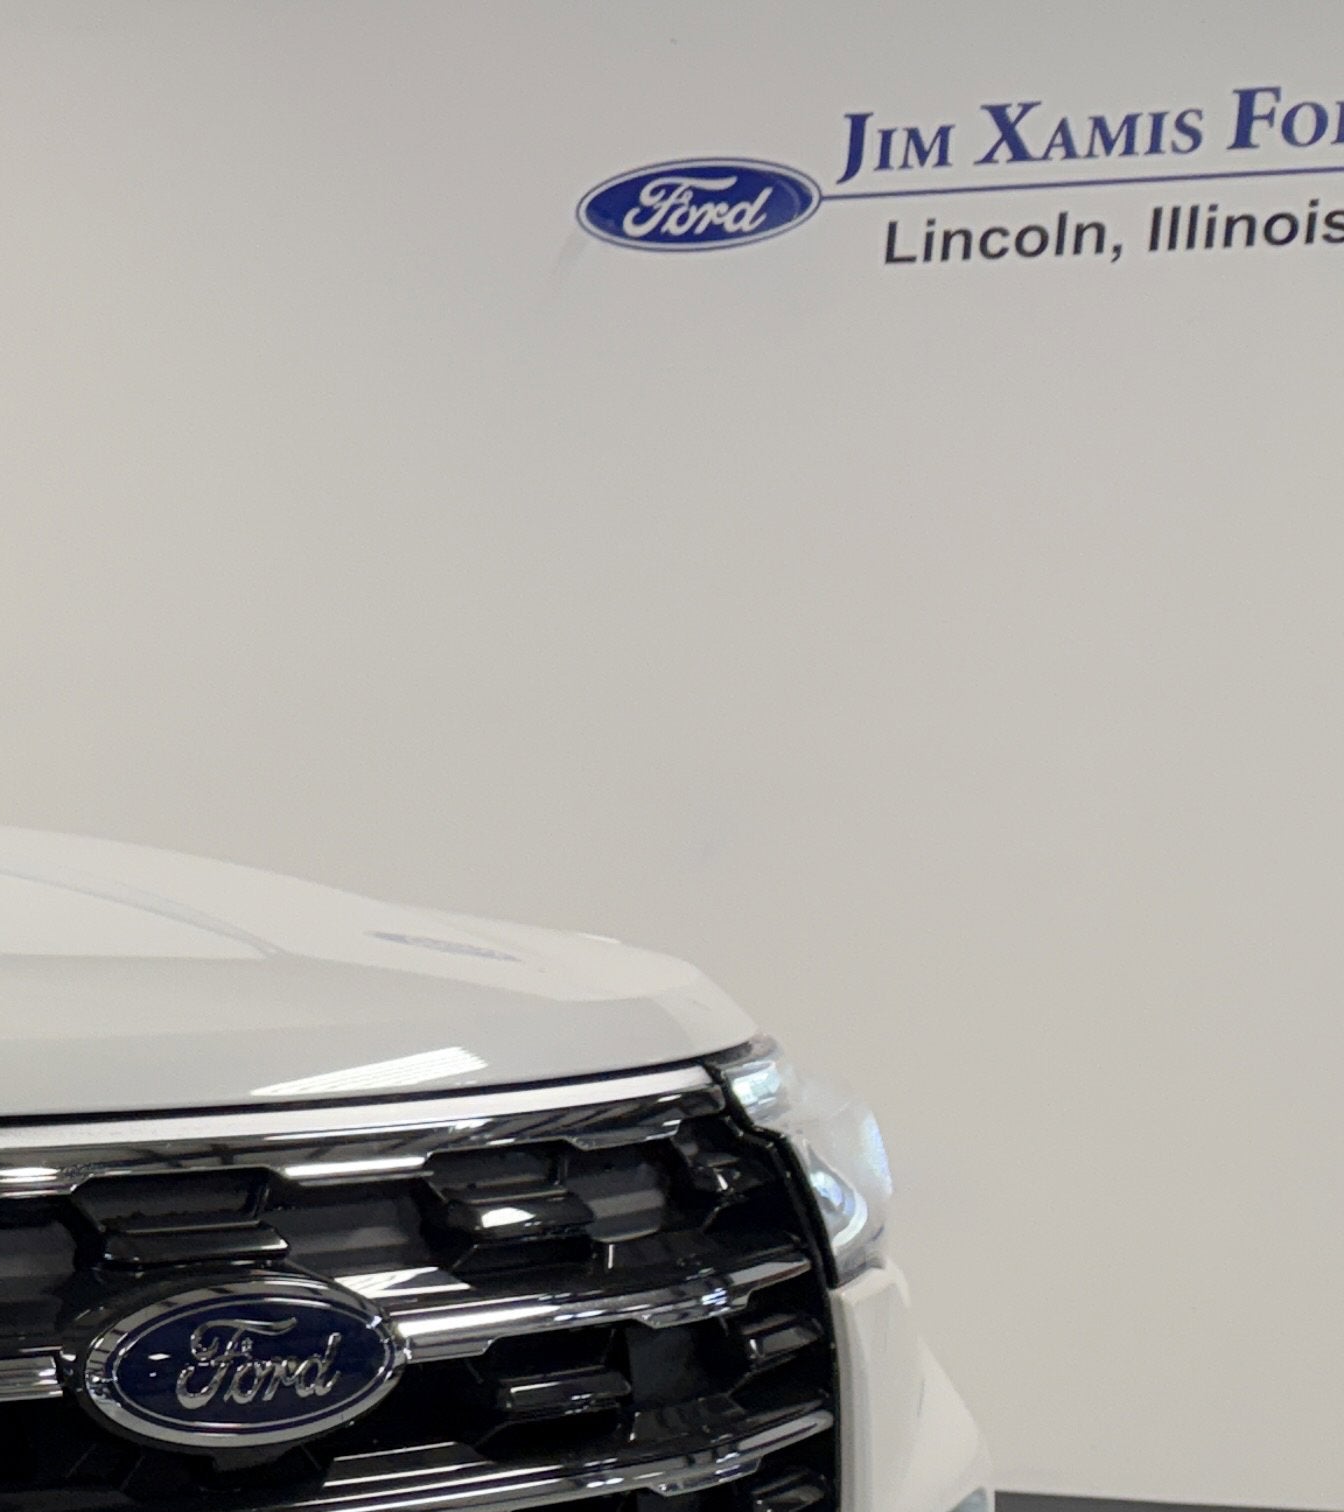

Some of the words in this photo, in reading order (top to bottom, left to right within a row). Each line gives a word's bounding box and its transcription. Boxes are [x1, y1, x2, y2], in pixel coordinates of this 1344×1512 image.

[835, 112, 956, 185] JIM
[973, 101, 1204, 166] XAMIS
[622, 175, 768, 238] Ford
[884, 212, 1123, 265] Lincoln,
[1148, 199, 1344, 253] Illinois
[175, 1316, 343, 1410] Ford
